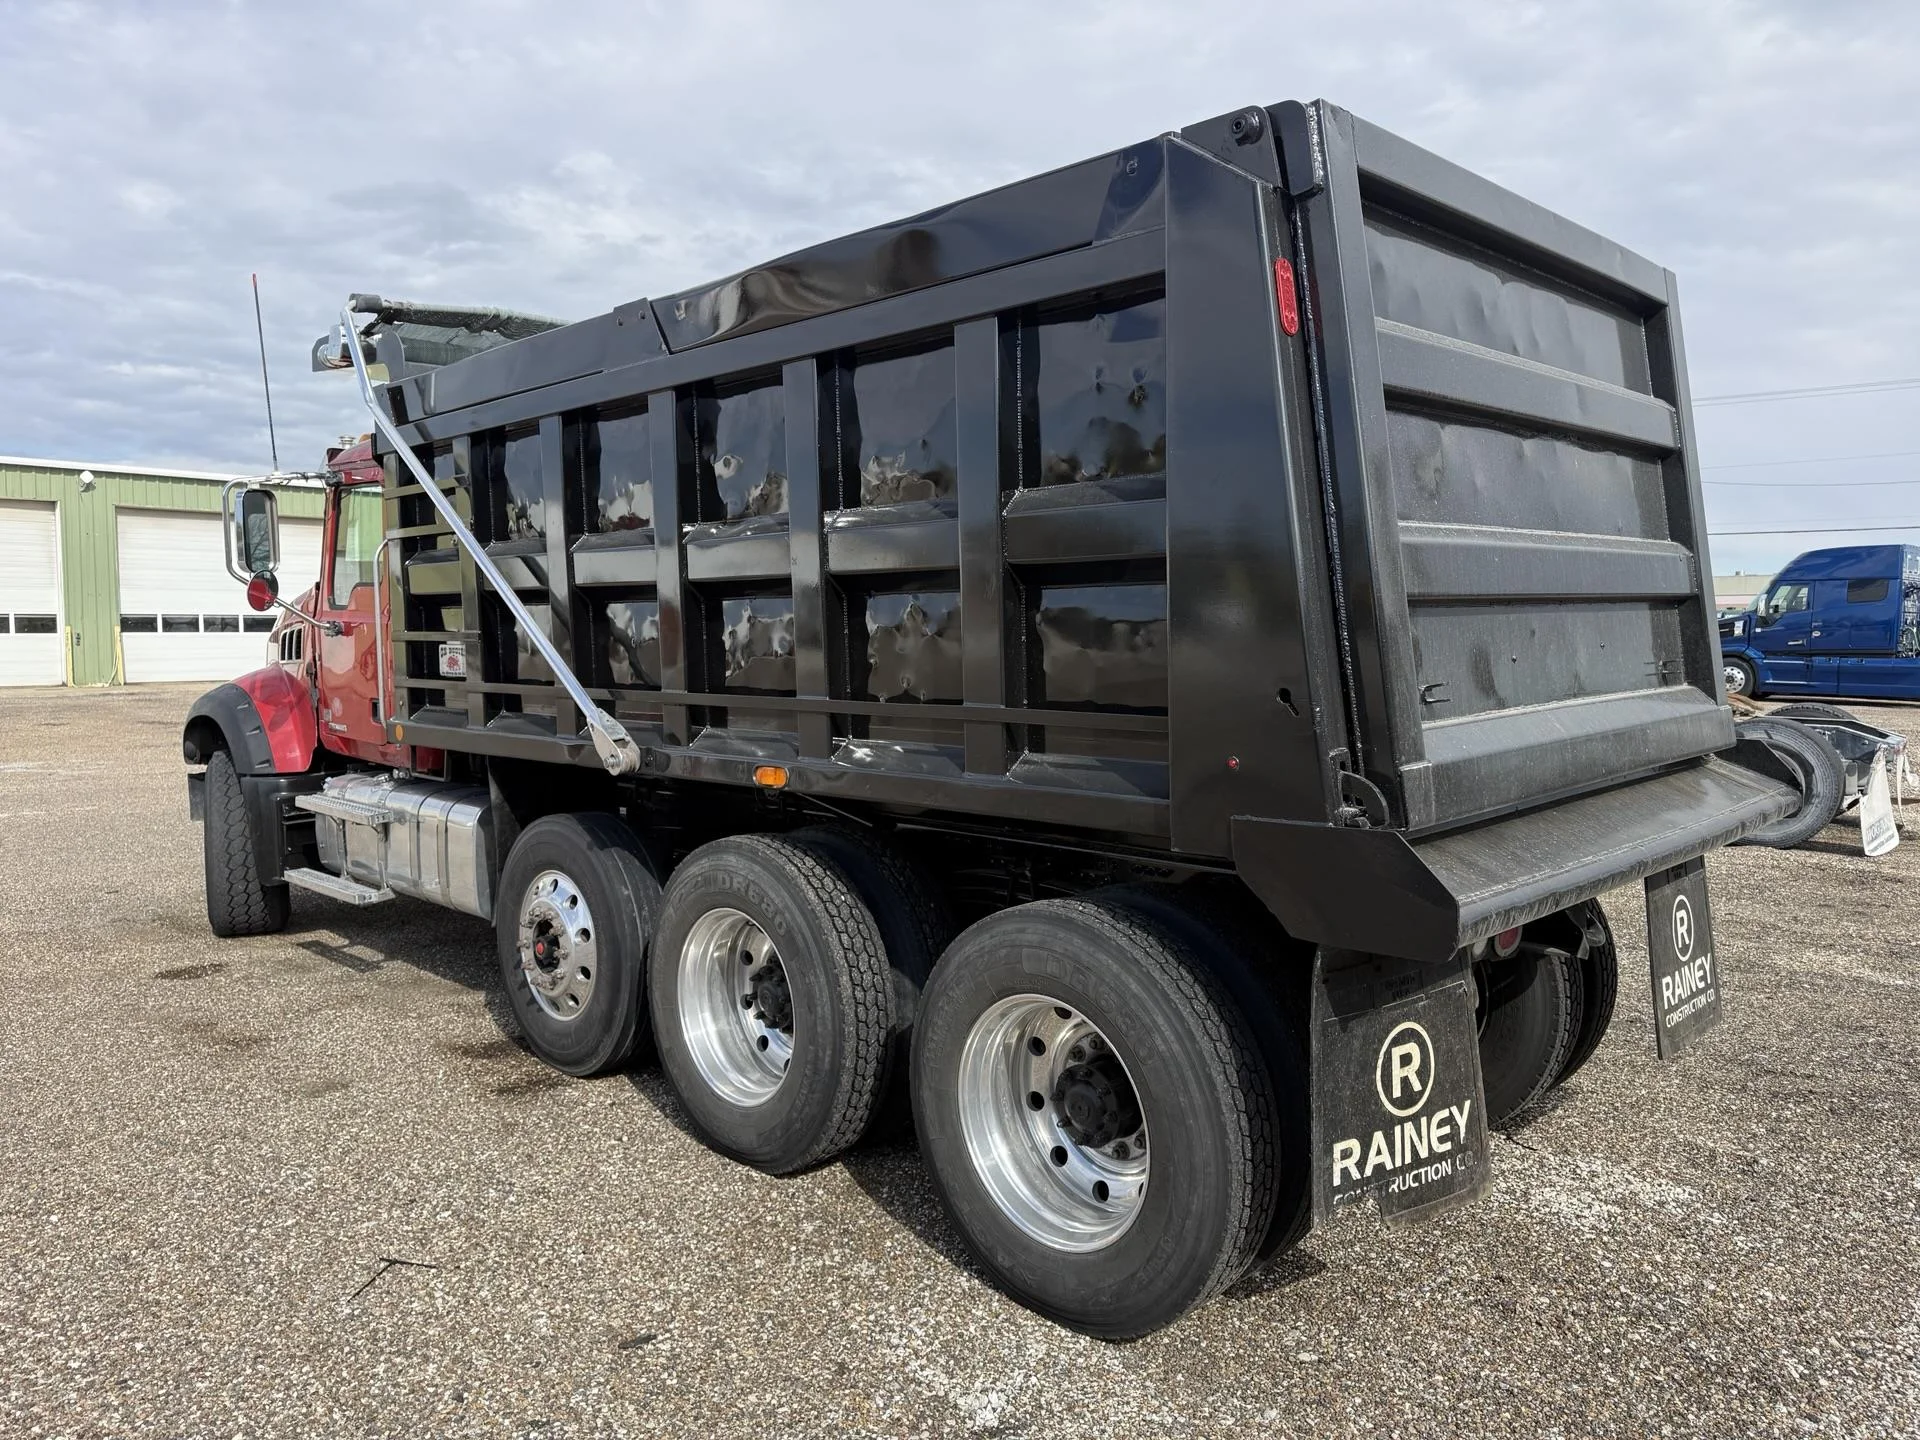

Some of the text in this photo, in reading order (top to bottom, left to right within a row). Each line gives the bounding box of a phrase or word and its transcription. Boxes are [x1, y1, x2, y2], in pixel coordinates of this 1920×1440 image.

[1661, 953, 1711, 1009] RAINEY
[1665, 997, 1706, 1028] CONSTRUCTION
[1332, 1099, 1471, 1187] RAINEY
